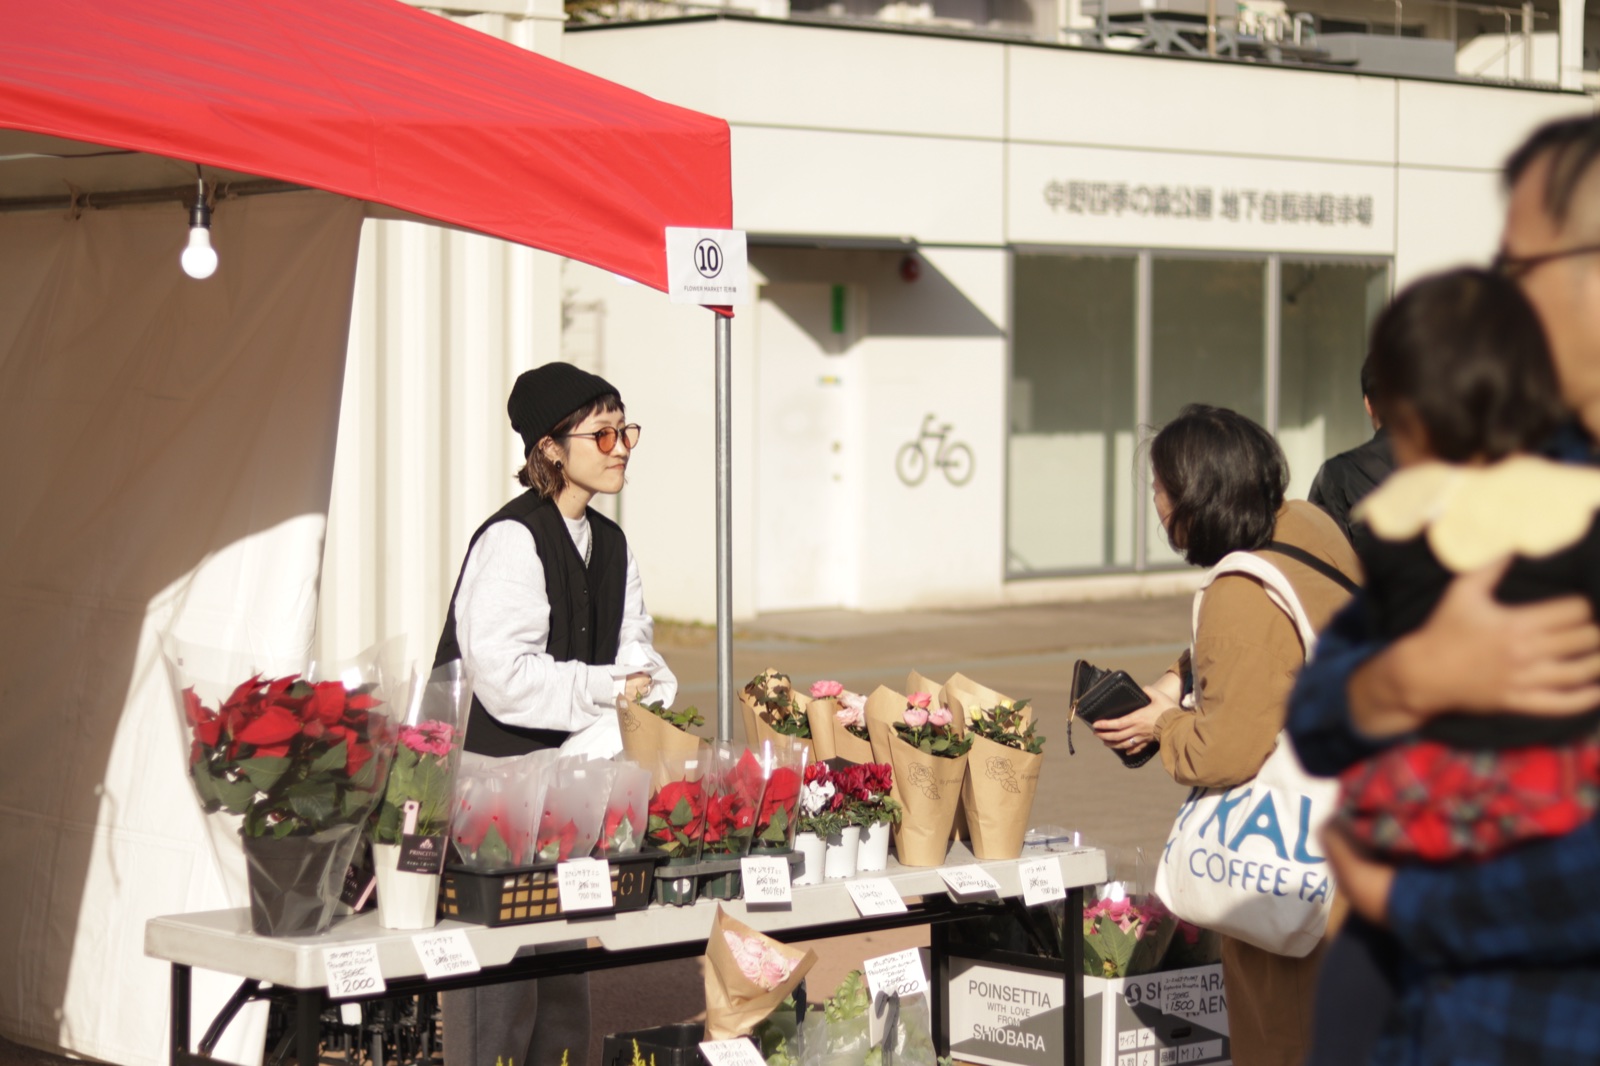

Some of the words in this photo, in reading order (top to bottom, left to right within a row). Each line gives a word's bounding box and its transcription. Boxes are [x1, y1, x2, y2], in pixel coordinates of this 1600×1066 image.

[698, 245, 719, 272] 10
[683, 285, 703, 293] FLOWER
[704, 286, 722, 294] MARKET
[1189, 847, 1292, 898] COFFEE
[968, 979, 1052, 1009] POINSETTIA
[986, 1001, 1007, 1013] WITH
[1010, 1005, 1031, 1018] LOVE
[997, 1014, 1021, 1028] FROM
[972, 1023, 1046, 1053] SHIOBARA
[1119, 1034, 1136, 1046] サイズ
[1180, 1046, 1206, 1061] MIX
